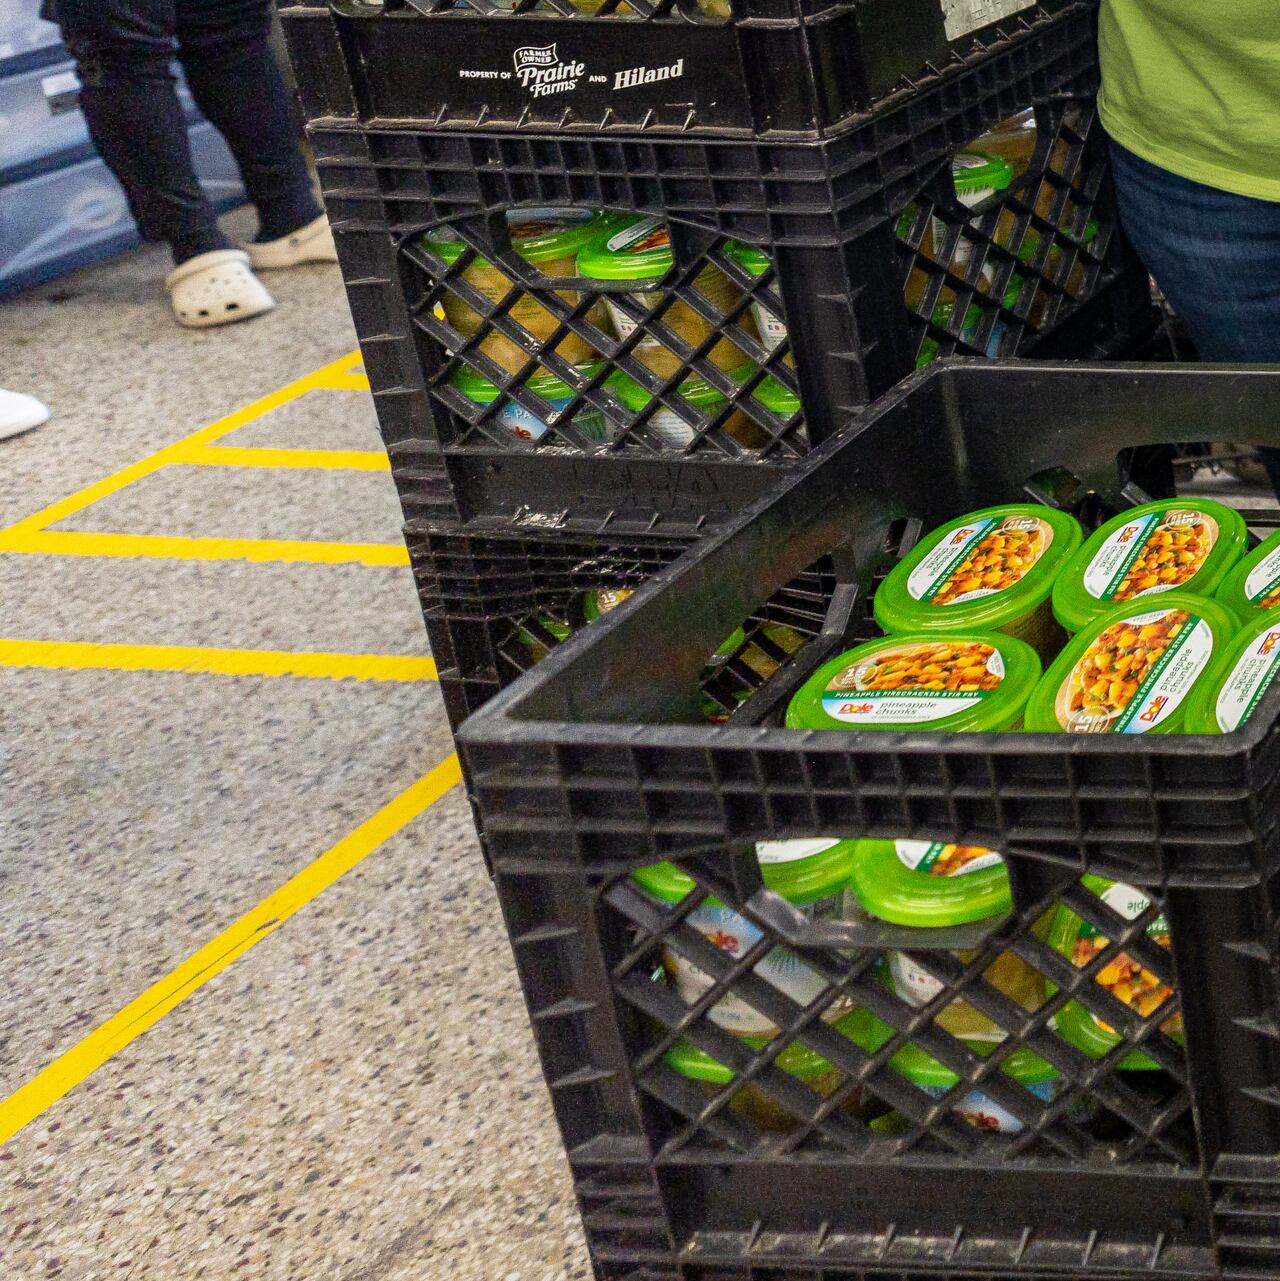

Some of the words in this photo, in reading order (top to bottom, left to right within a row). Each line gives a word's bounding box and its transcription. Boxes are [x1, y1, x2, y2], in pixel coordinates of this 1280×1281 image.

[519, 49, 552, 58] FARMER
[521, 56, 552, 64] OWNED
[459, 70, 499, 79] PROPERTY
[517, 60, 586, 87] Prairie
[589, 75, 608, 83] AND
[612, 59, 684, 90] Hiland
[530, 79, 578, 98] Farms
[950, 528, 976, 546] Dole
[974, 520, 998, 546] PINEAPPLE
[1119, 526, 1140, 543] Dole
[1139, 517, 1160, 544] PINEAPPLE
[926, 547, 949, 569] chunks
[928, 547, 959, 577] pineapple
[948, 542, 978, 575] FIRECRACKER
[1100, 545, 1119, 569] chunks
[1103, 545, 1127, 577] pineapple
[1122, 541, 1145, 570] FIRECRACKER
[936, 572, 952, 588] STIR
[1114, 568, 1127, 583] STIR
[928, 584, 941, 598] FRY
[1106, 580, 1119, 596] FRY
[1259, 586, 1273, 599] FRY
[1115, 692, 1145, 732] PINEAPPLE
[1140, 650, 1175, 695] FIRECRACKER
[1170, 635, 1185, 652] STIR
[1181, 623, 1194, 638] FRY
[1139, 695, 1168, 722] Dole
[1159, 648, 1193, 691] pineapple
[1169, 661, 1194, 693] chunks
[1234, 659, 1257, 690] chunks
[1237, 659, 1266, 703] pineapple
[834, 691, 880, 699] PINEAPPLE
[881, 691, 941, 699] FIRECRACKER
[943, 691, 962, 699] STIR
[963, 691, 980, 699] FRY
[838, 702, 874, 713] Dole
[879, 701, 938, 711] pineapple
[875, 707, 918, 716] chunks
